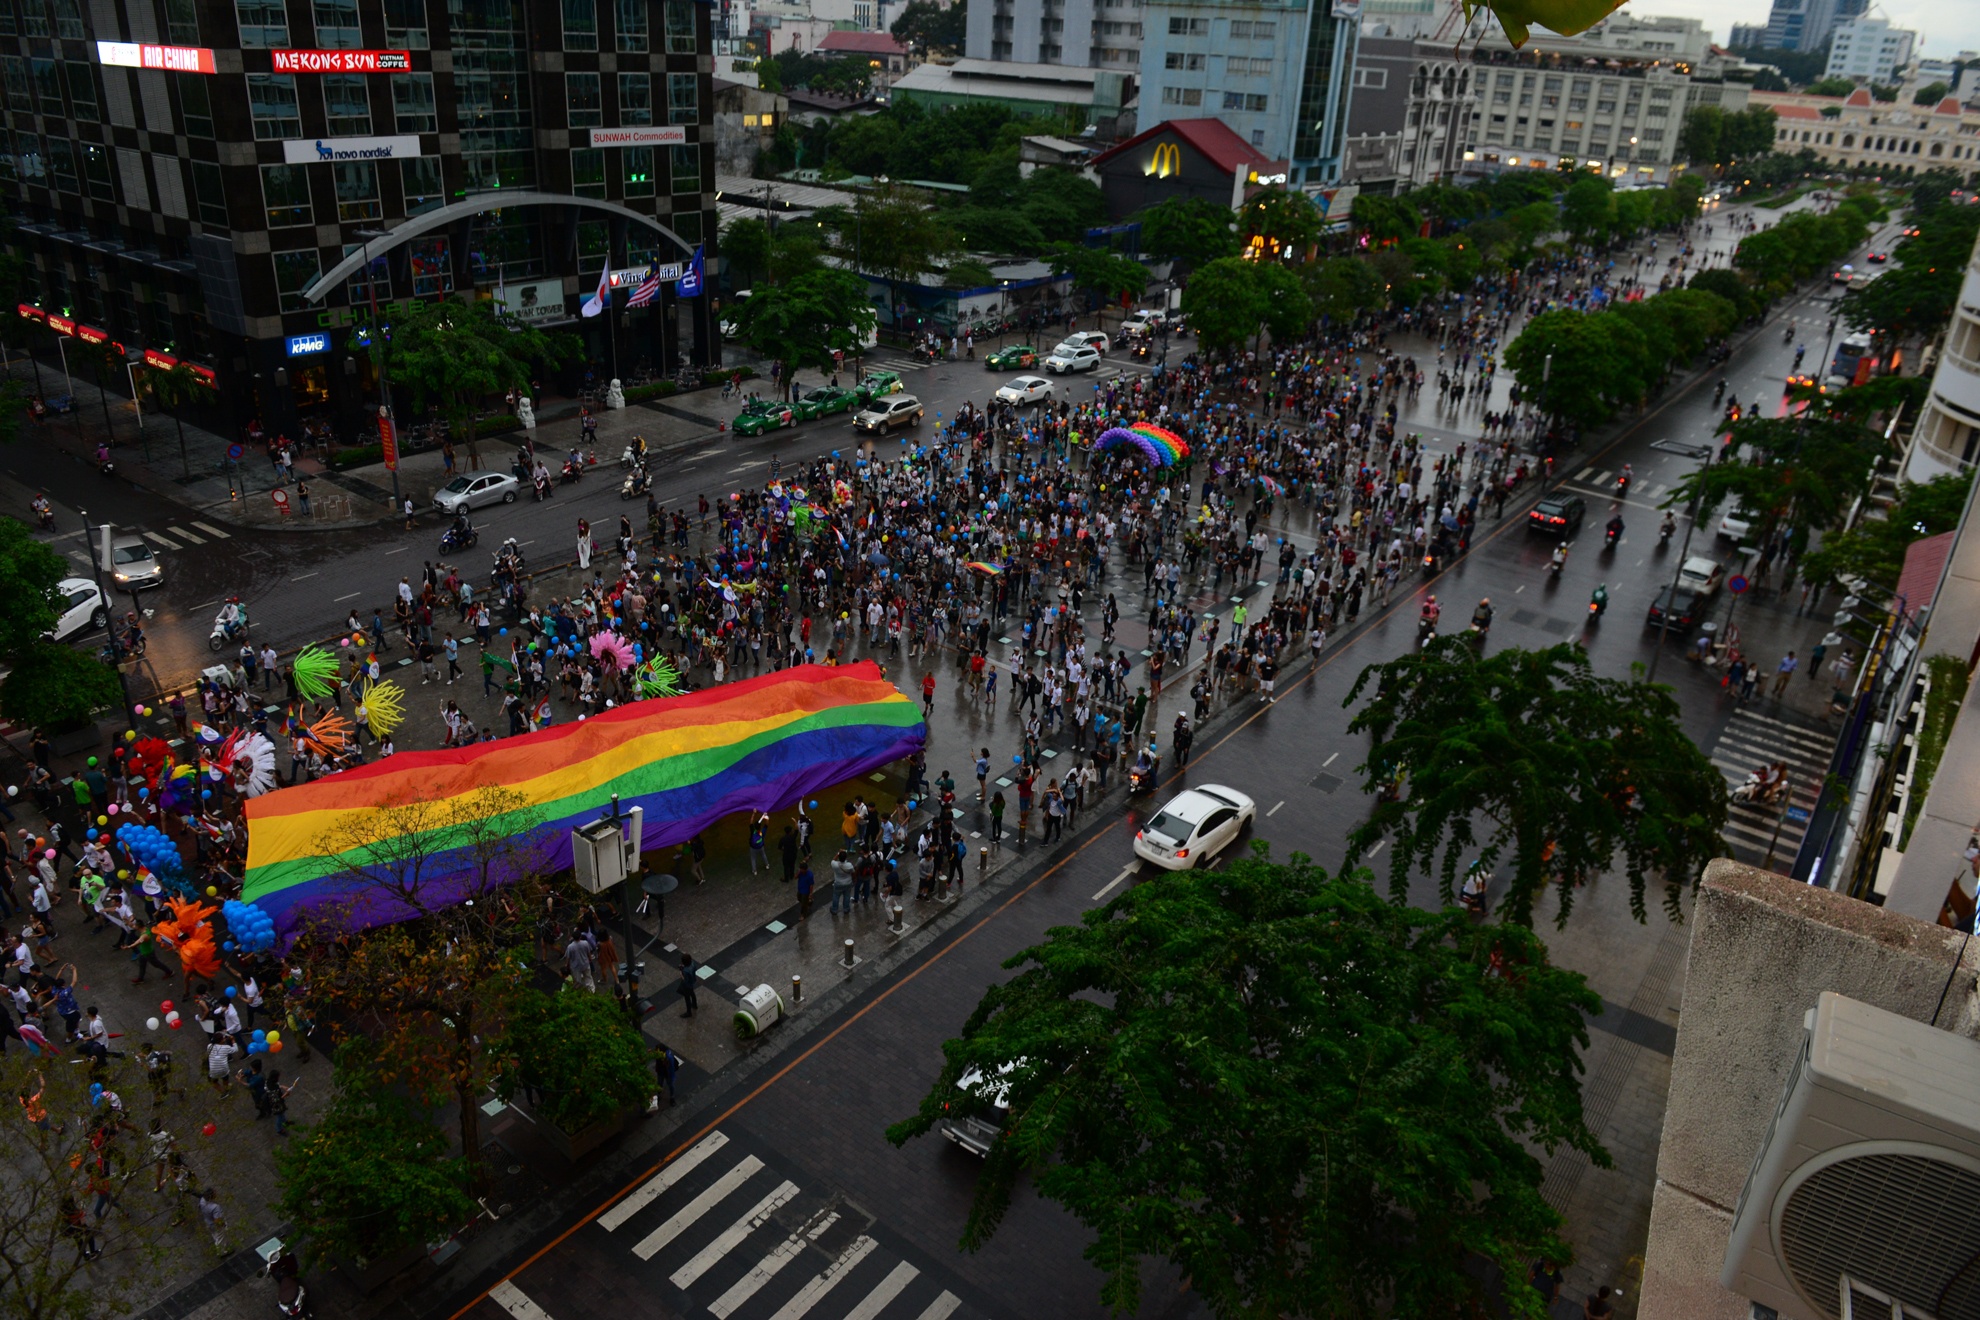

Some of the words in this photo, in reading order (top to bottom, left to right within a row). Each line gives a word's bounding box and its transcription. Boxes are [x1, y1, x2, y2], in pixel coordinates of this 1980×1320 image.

[144, 46, 163, 67] AIR
[164, 48, 199, 71] CHINA
[275, 52, 340, 70] MEKONG
[344, 53, 375, 69] SUN
[376, 60, 409, 68] COFFEE
[594, 133, 631, 143] SUNWAH
[633, 131, 684, 142] Commodities
[335, 150, 358, 159] novo
[536, 304, 563, 316] TOWER
[292, 340, 324, 354] KPMG
